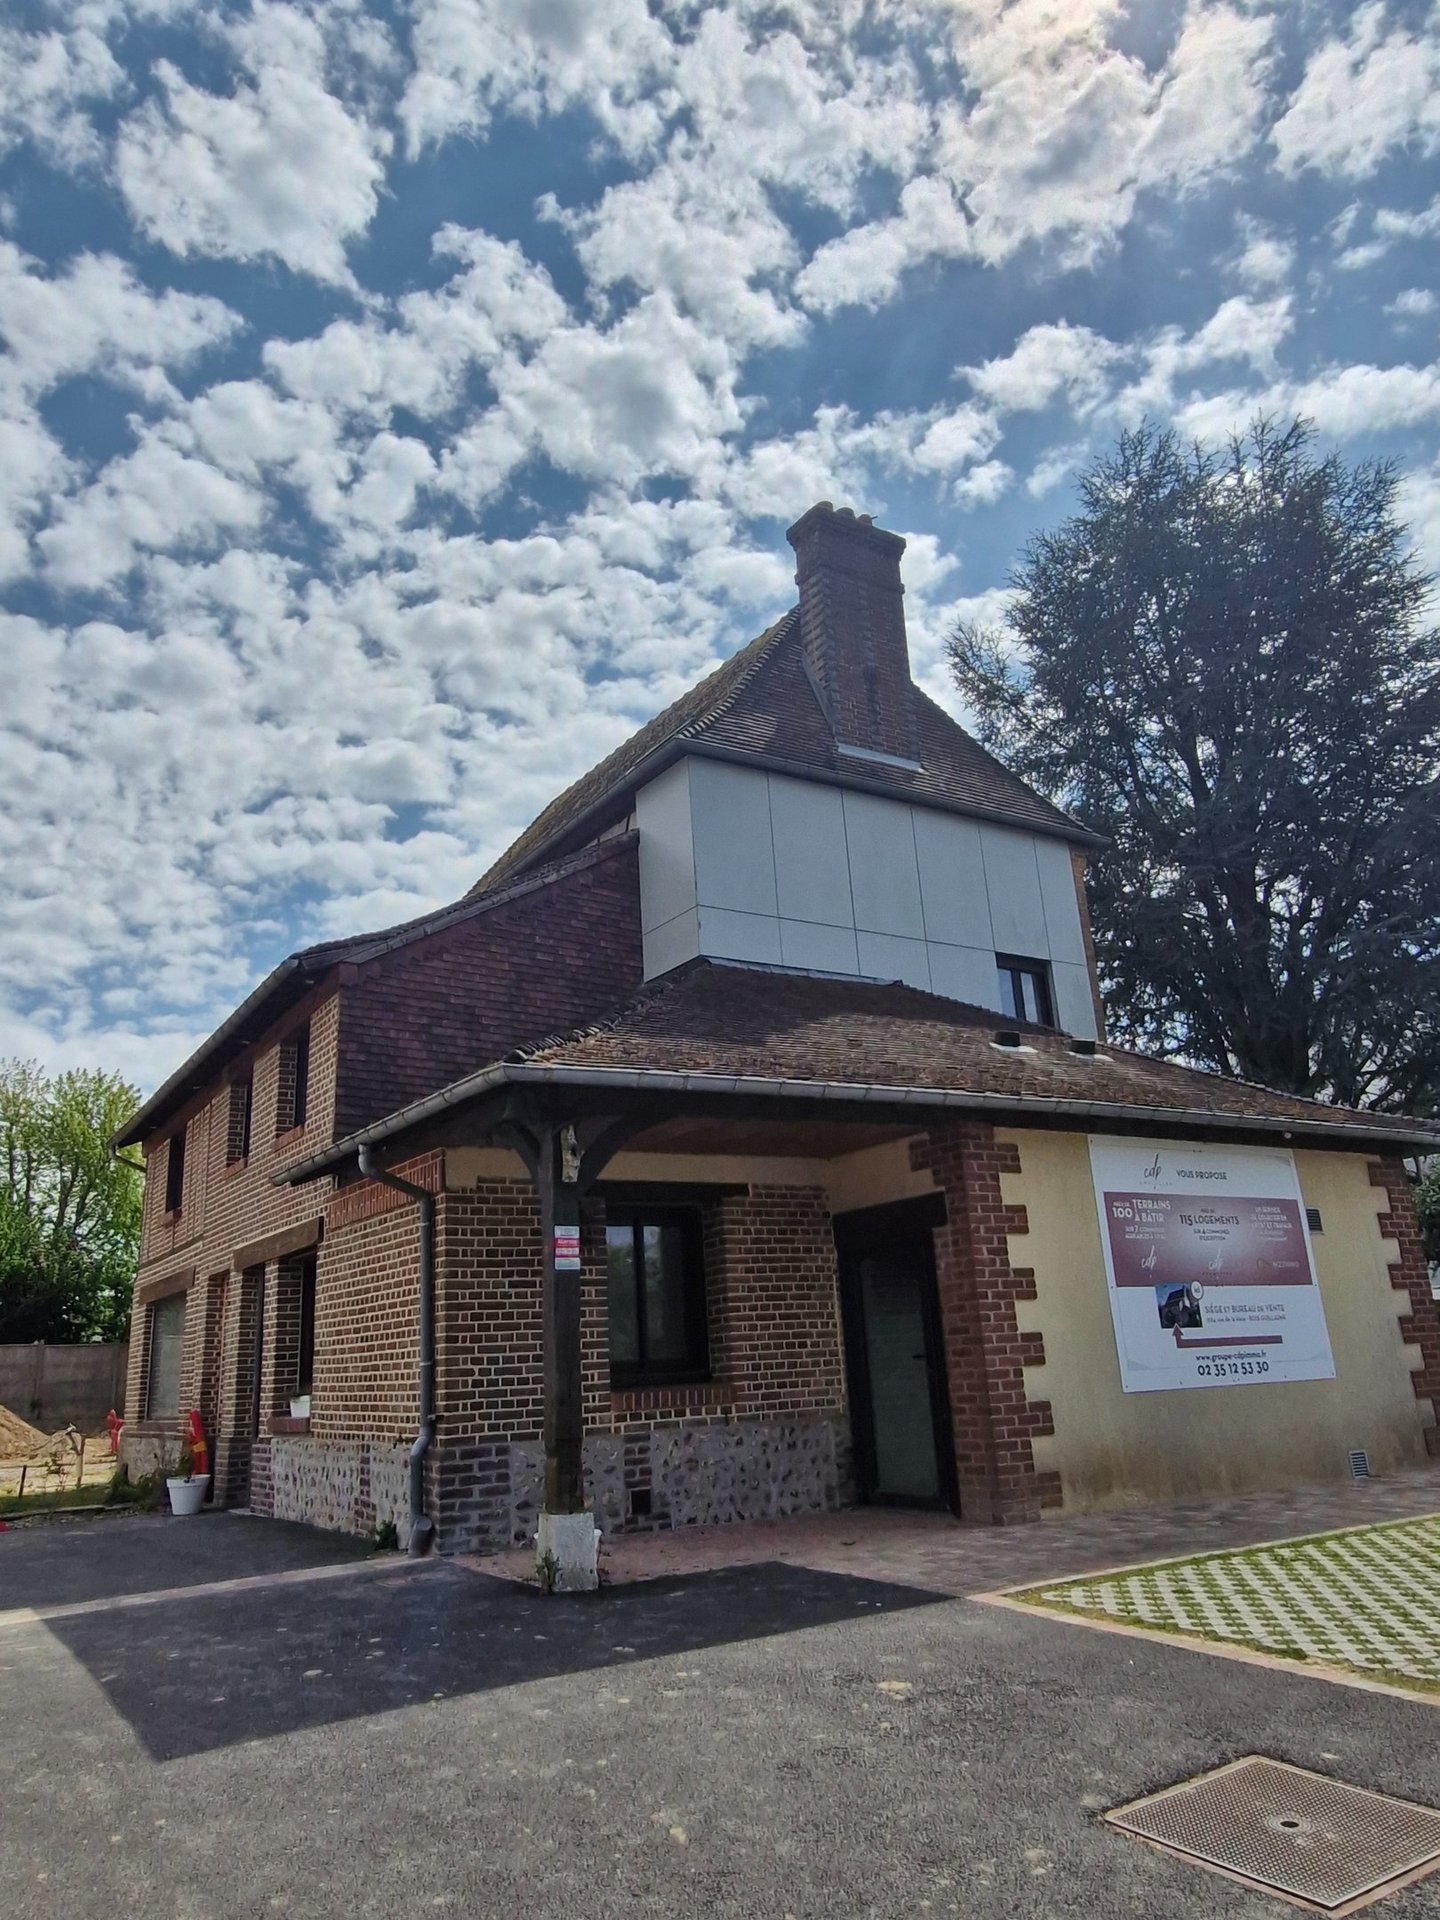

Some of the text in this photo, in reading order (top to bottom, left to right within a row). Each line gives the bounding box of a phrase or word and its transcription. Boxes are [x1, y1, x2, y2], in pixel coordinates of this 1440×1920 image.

[1176, 1169, 1227, 1180] VOUS PROPOSE
[1132, 1199, 1170, 1210] TERRAINS
[1112, 1207, 1132, 1218] 100
[1179, 1214, 1193, 1226] 115
[1194, 1215, 1239, 1225] LOGEMENTS
[1197, 1361, 1269, 1377] 02 35 12 53 30
